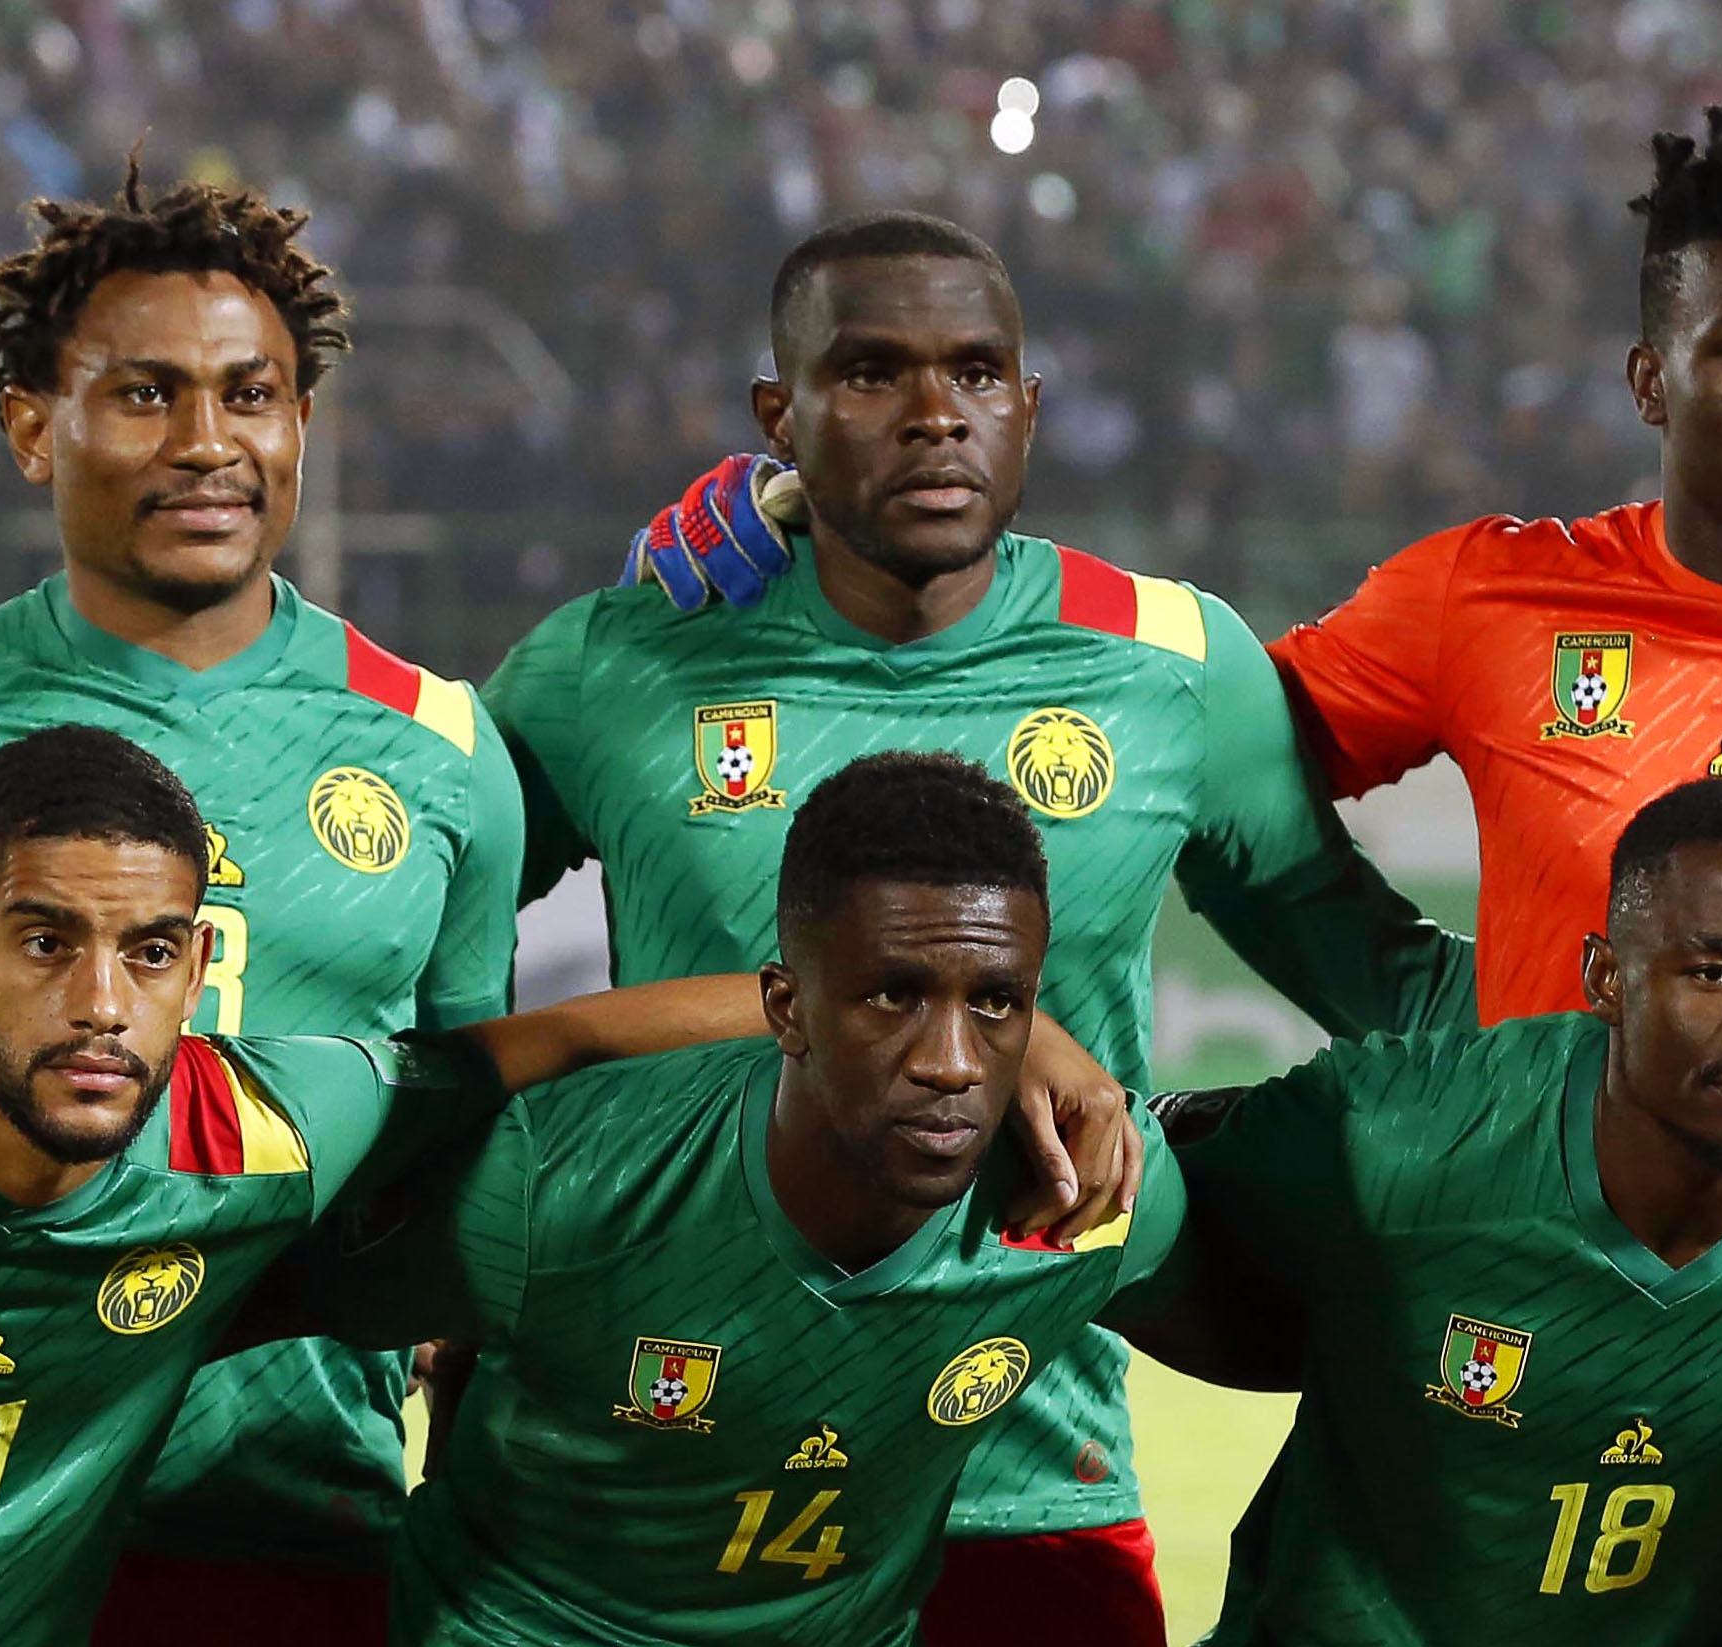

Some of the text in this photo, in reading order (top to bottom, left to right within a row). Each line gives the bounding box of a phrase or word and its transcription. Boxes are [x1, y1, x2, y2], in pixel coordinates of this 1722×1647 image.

[1561, 635, 1626, 650] CAMEROUN
[702, 707, 769, 722] CAMEROUN
[1456, 1320, 1523, 1344] CAMEROUN
[642, 1342, 712, 1360] CAMEROUN
[716, 1490, 845, 1580] 14
[1539, 1482, 1676, 1595] 18
